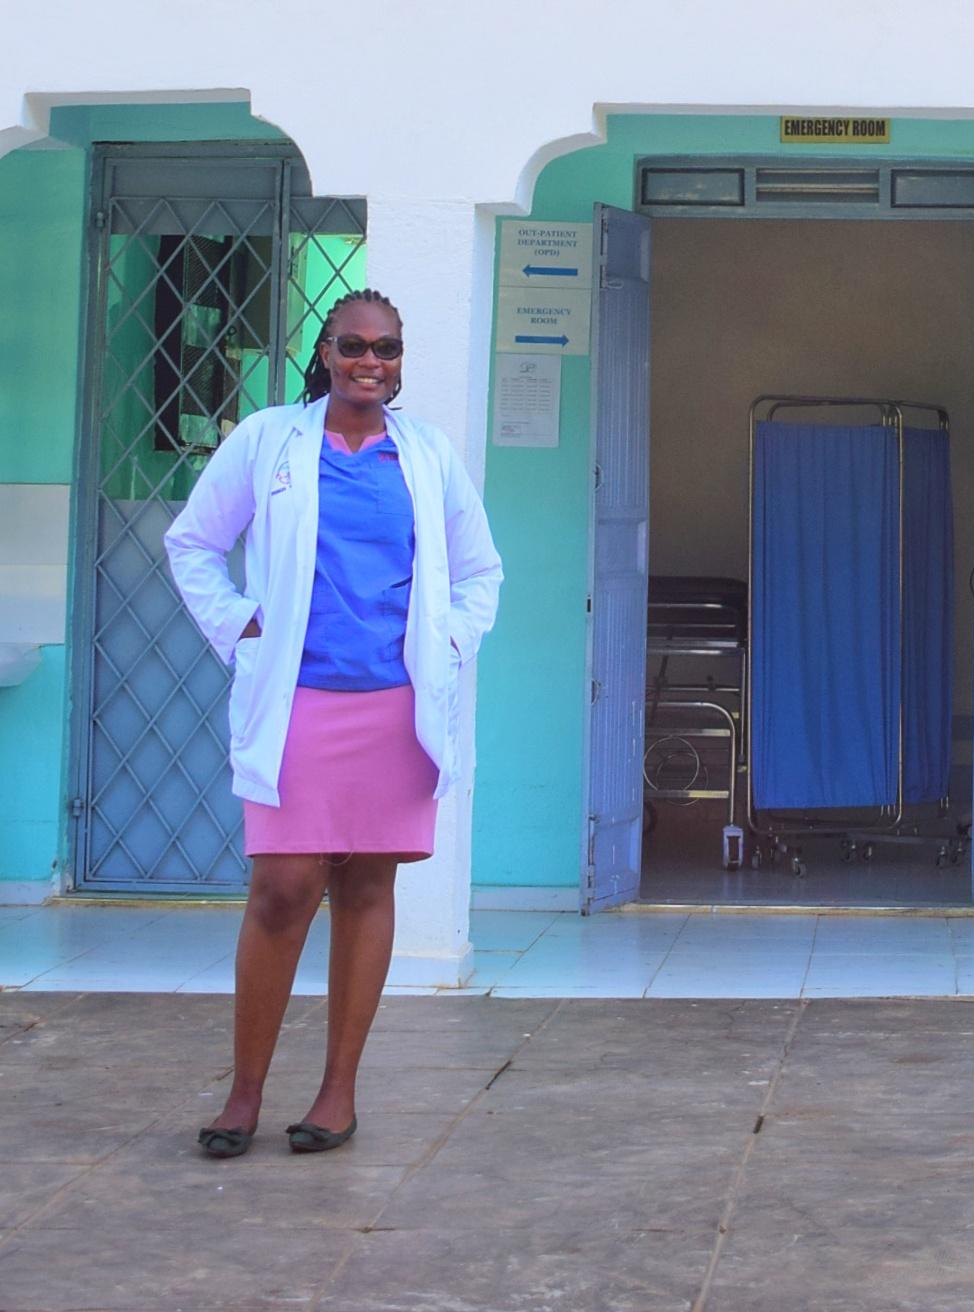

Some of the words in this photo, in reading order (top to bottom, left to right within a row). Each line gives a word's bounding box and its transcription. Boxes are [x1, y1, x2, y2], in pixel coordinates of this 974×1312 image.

[784, 119, 850, 136] EMERGENCY
[853, 120, 885, 136] ROOM
[518, 229, 576, 238] OUT-PATIENT
[517, 239, 577, 247] DEPARTMENT
[534, 248, 560, 256] (OPD)
[516, 307, 571, 316] EMERGENCY
[530, 317, 557, 325] ROOM
